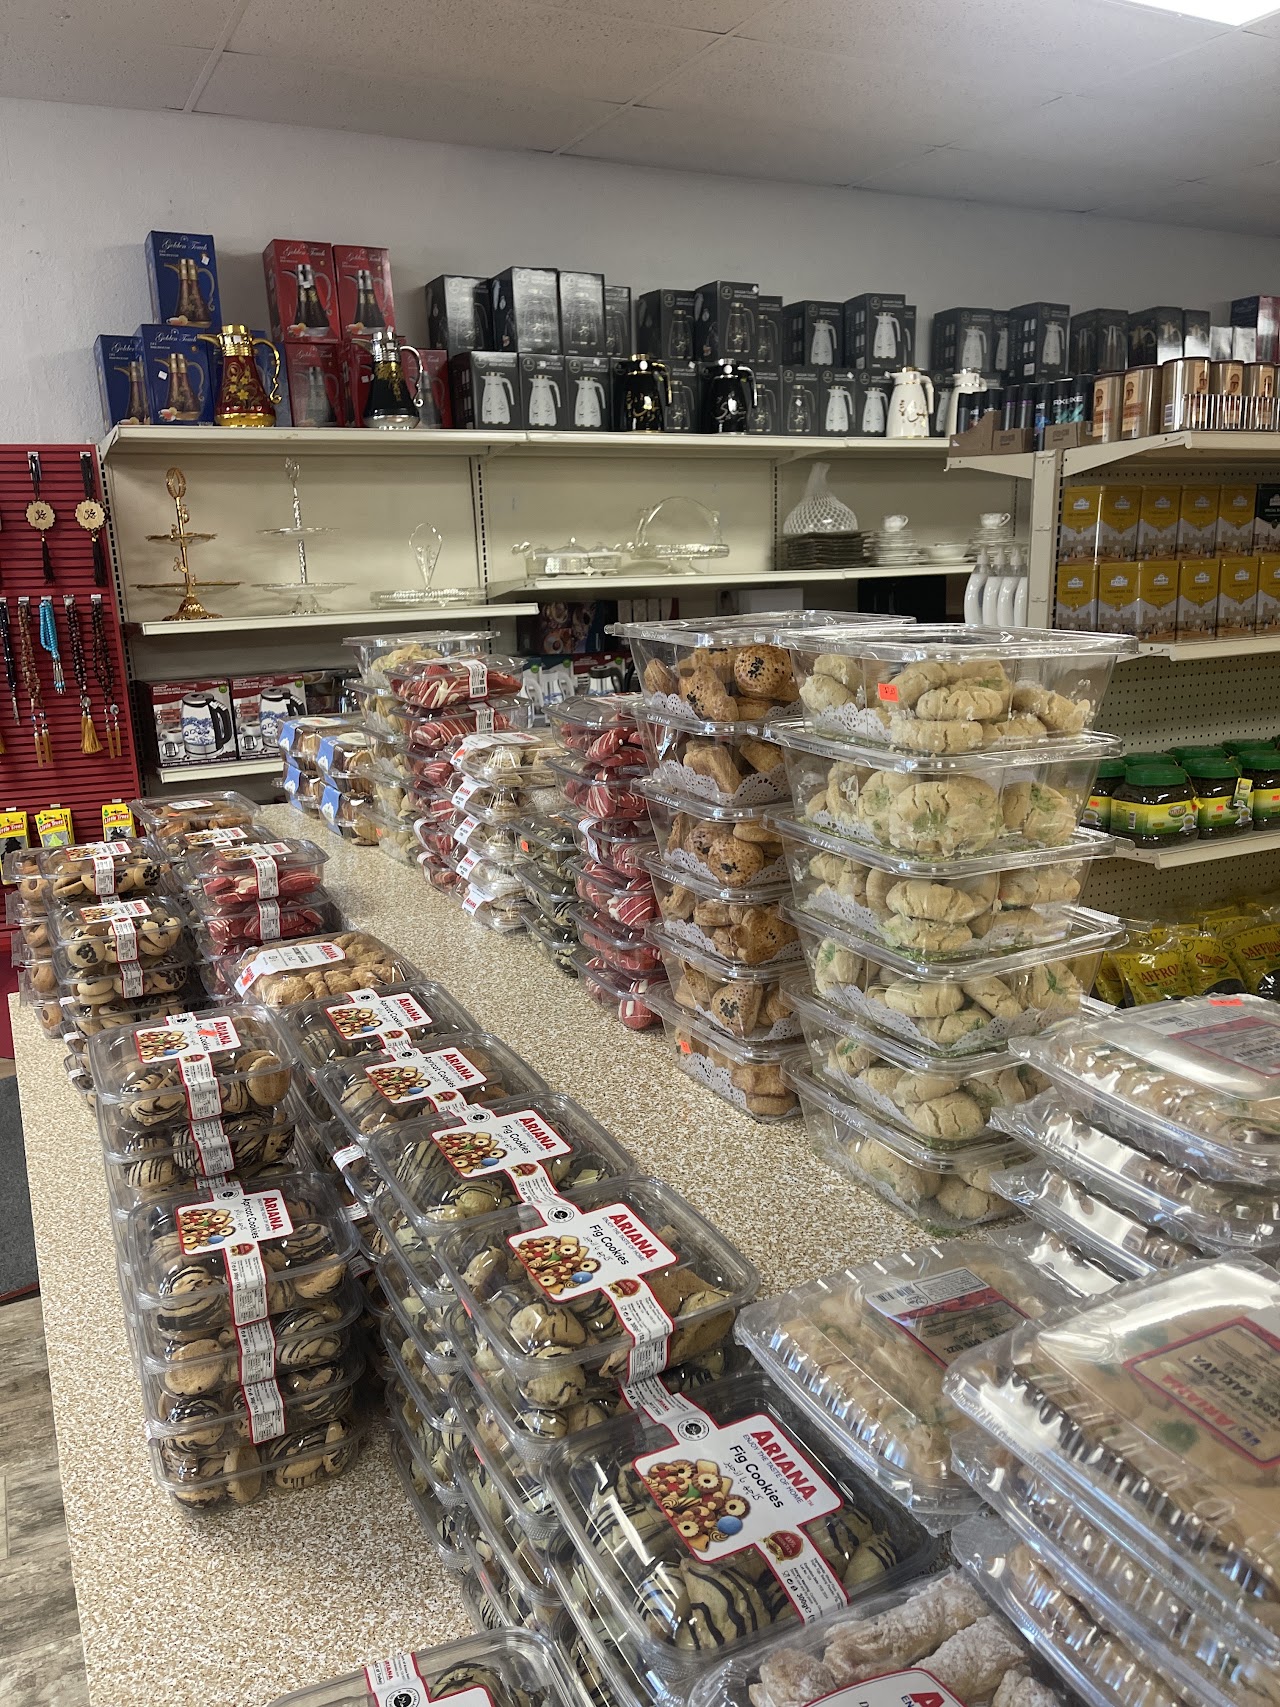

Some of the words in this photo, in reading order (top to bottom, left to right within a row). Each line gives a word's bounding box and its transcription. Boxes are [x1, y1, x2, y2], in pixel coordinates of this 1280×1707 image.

[104, 815, 117, 824] Little
[390, 1012, 405, 1028] Cookies
[397, 998, 423, 1023] ARIANA
[213, 1021, 232, 1046] ARIANA
[423, 1056, 441, 1073] Apricot
[436, 1071, 457, 1088] Cookies
[443, 1053, 476, 1081] ARIANA
[502, 1124, 513, 1135] Fig
[510, 1132, 531, 1154] Cookies
[519, 1117, 557, 1150] ARIANA
[241, 1198, 254, 1217] Apricot
[263, 1197, 284, 1231] ARIANA
[247, 1217, 260, 1239] Cookies
[602, 1216, 615, 1228] ENJOY
[619, 1234, 631, 1246] TASTE
[633, 1250, 646, 1262] HOME
[608, 1213, 658, 1259] ARIANA
[589, 1224, 604, 1238] Fig
[600, 1236, 630, 1266] Cookies
[729, 1444, 748, 1464] Fig
[745, 1463, 784, 1508] Cookies
[743, 1433, 760, 1451] ENJOY
[757, 1450, 769, 1462] THE
[766, 1461, 783, 1478] TASTE
[785, 1486, 803, 1505] HOME
[750, 1430, 818, 1501] ARIANA
